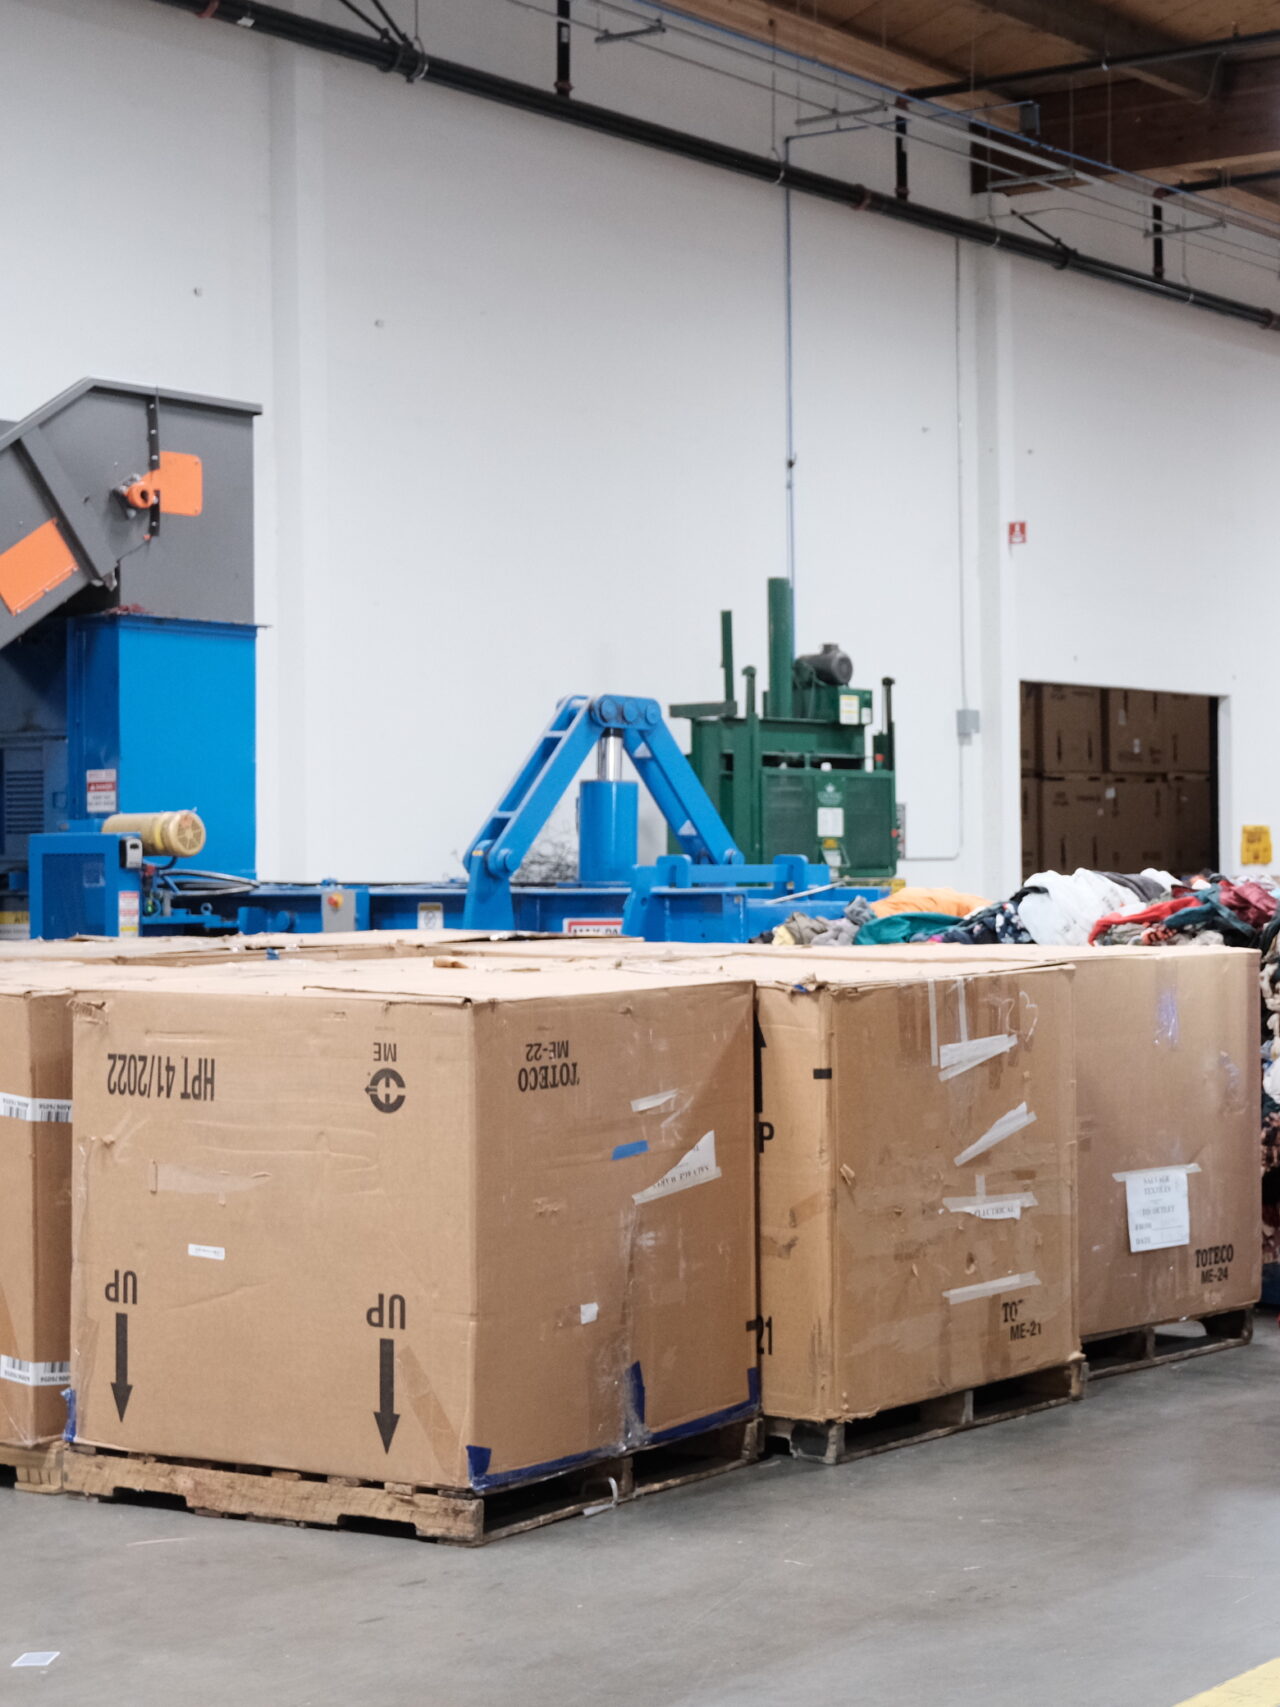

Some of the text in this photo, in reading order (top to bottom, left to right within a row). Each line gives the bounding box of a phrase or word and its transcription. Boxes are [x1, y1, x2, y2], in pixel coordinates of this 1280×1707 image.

[373, 1042, 397, 1062] ME
[526, 1040, 570, 1062] ME-22
[107, 1053, 215, 1101] HPT 41/2022
[518, 1062, 579, 1092] TOTECO
[1195, 1244, 1234, 1268] TOTECO
[104, 1269, 138, 1304] UP
[366, 1293, 405, 1329] UP
